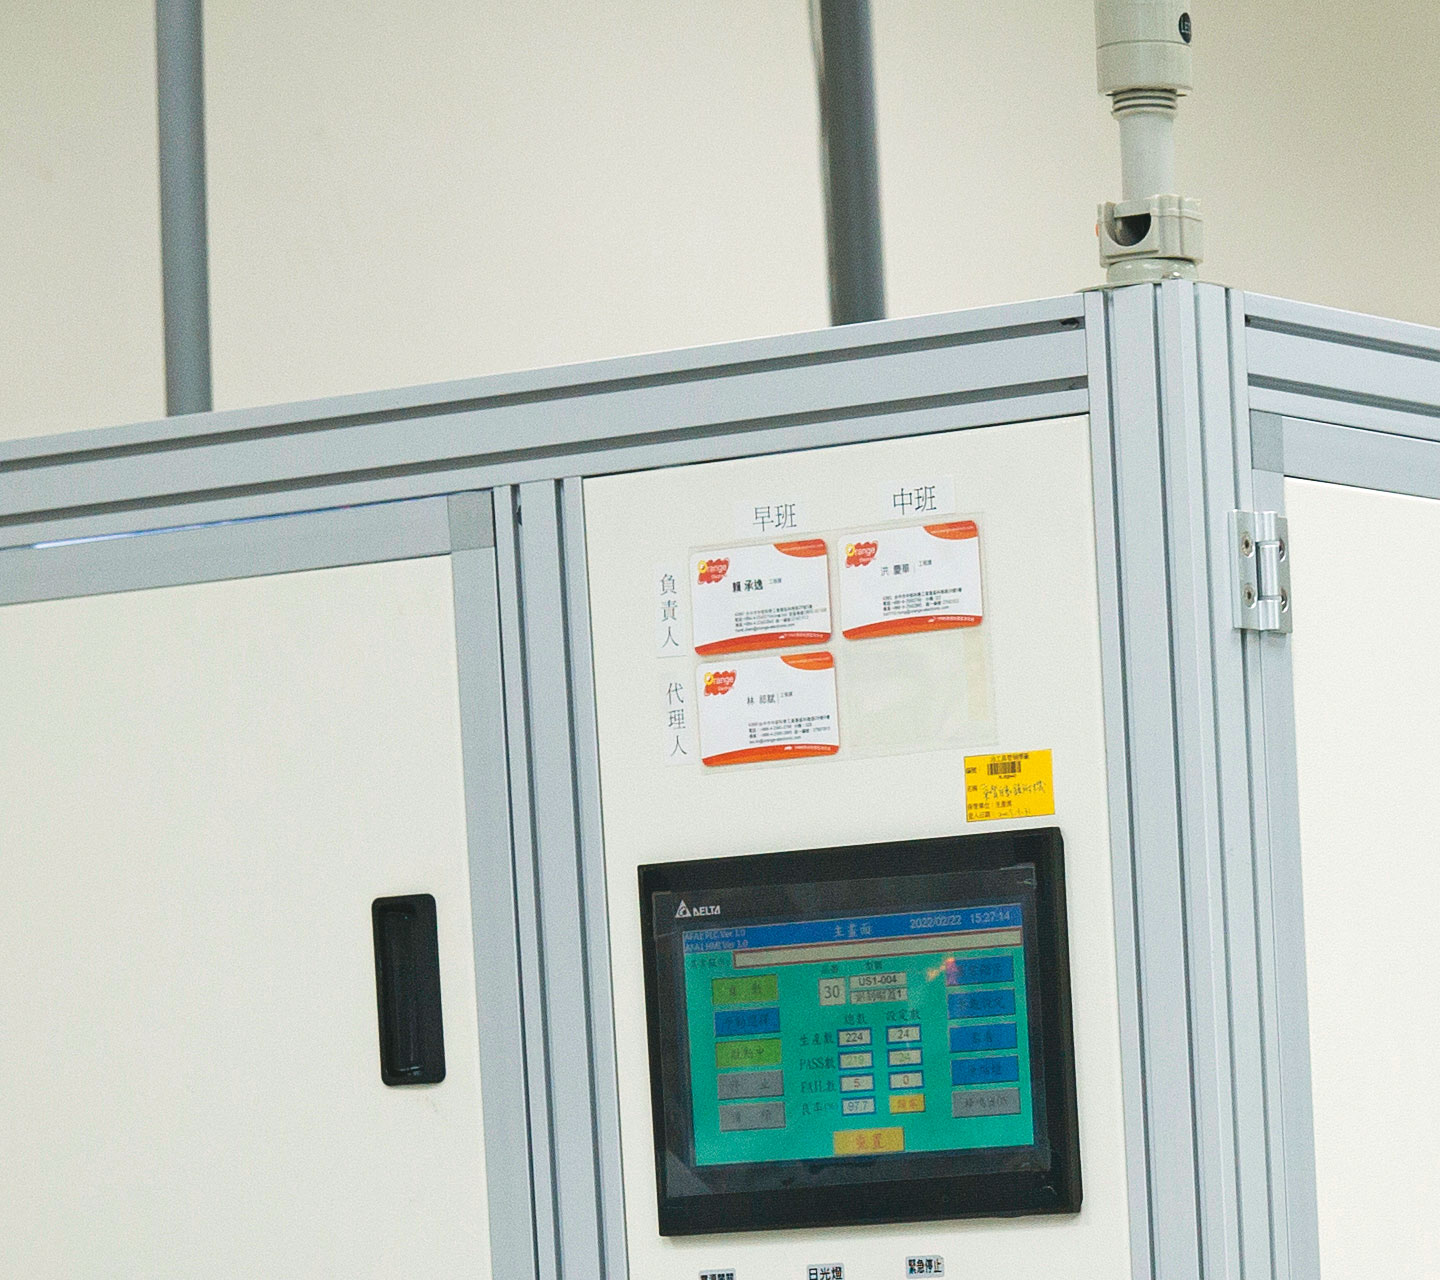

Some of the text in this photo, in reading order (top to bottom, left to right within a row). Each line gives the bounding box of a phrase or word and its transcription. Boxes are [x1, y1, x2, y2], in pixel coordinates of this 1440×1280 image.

[892, 486, 937, 516] 中班
[753, 503, 798, 532] 早班
[660, 573, 679, 648] 負責人
[666, 682, 688, 757] 代理人
[693, 905, 721, 917] DELTA
[858, 975, 898, 987] US1-004
[824, 985, 840, 999] 30
[845, 1032, 864, 1043] 224
[897, 1029, 910, 1040] 24
[853, 1078, 861, 1089] 5
[902, 1075, 910, 1086] 0
[908, 1258, 944, 1275] 緊急停止
